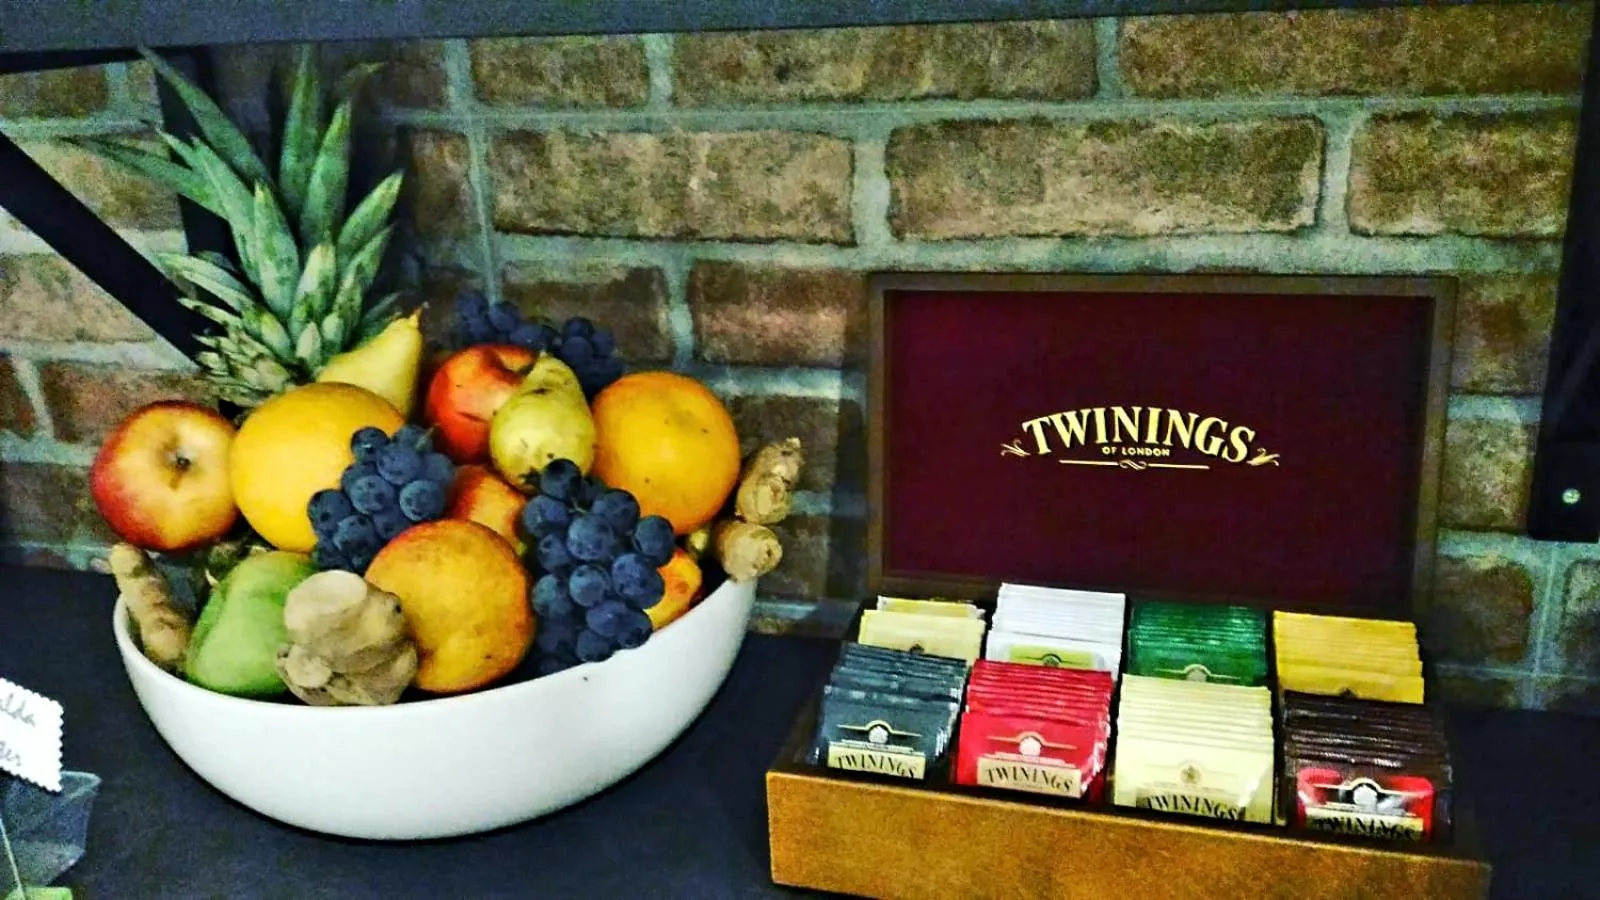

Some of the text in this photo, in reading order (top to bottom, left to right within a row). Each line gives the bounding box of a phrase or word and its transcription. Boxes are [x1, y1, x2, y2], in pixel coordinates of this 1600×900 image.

[1022, 406, 1256, 463] TWININGS
[1101, 446, 1170, 457] OF LONDON
[837, 753, 918, 778] TWININGS
[985, 765, 1074, 792] TWININGS
[1142, 794, 1238, 821] TWININGS
